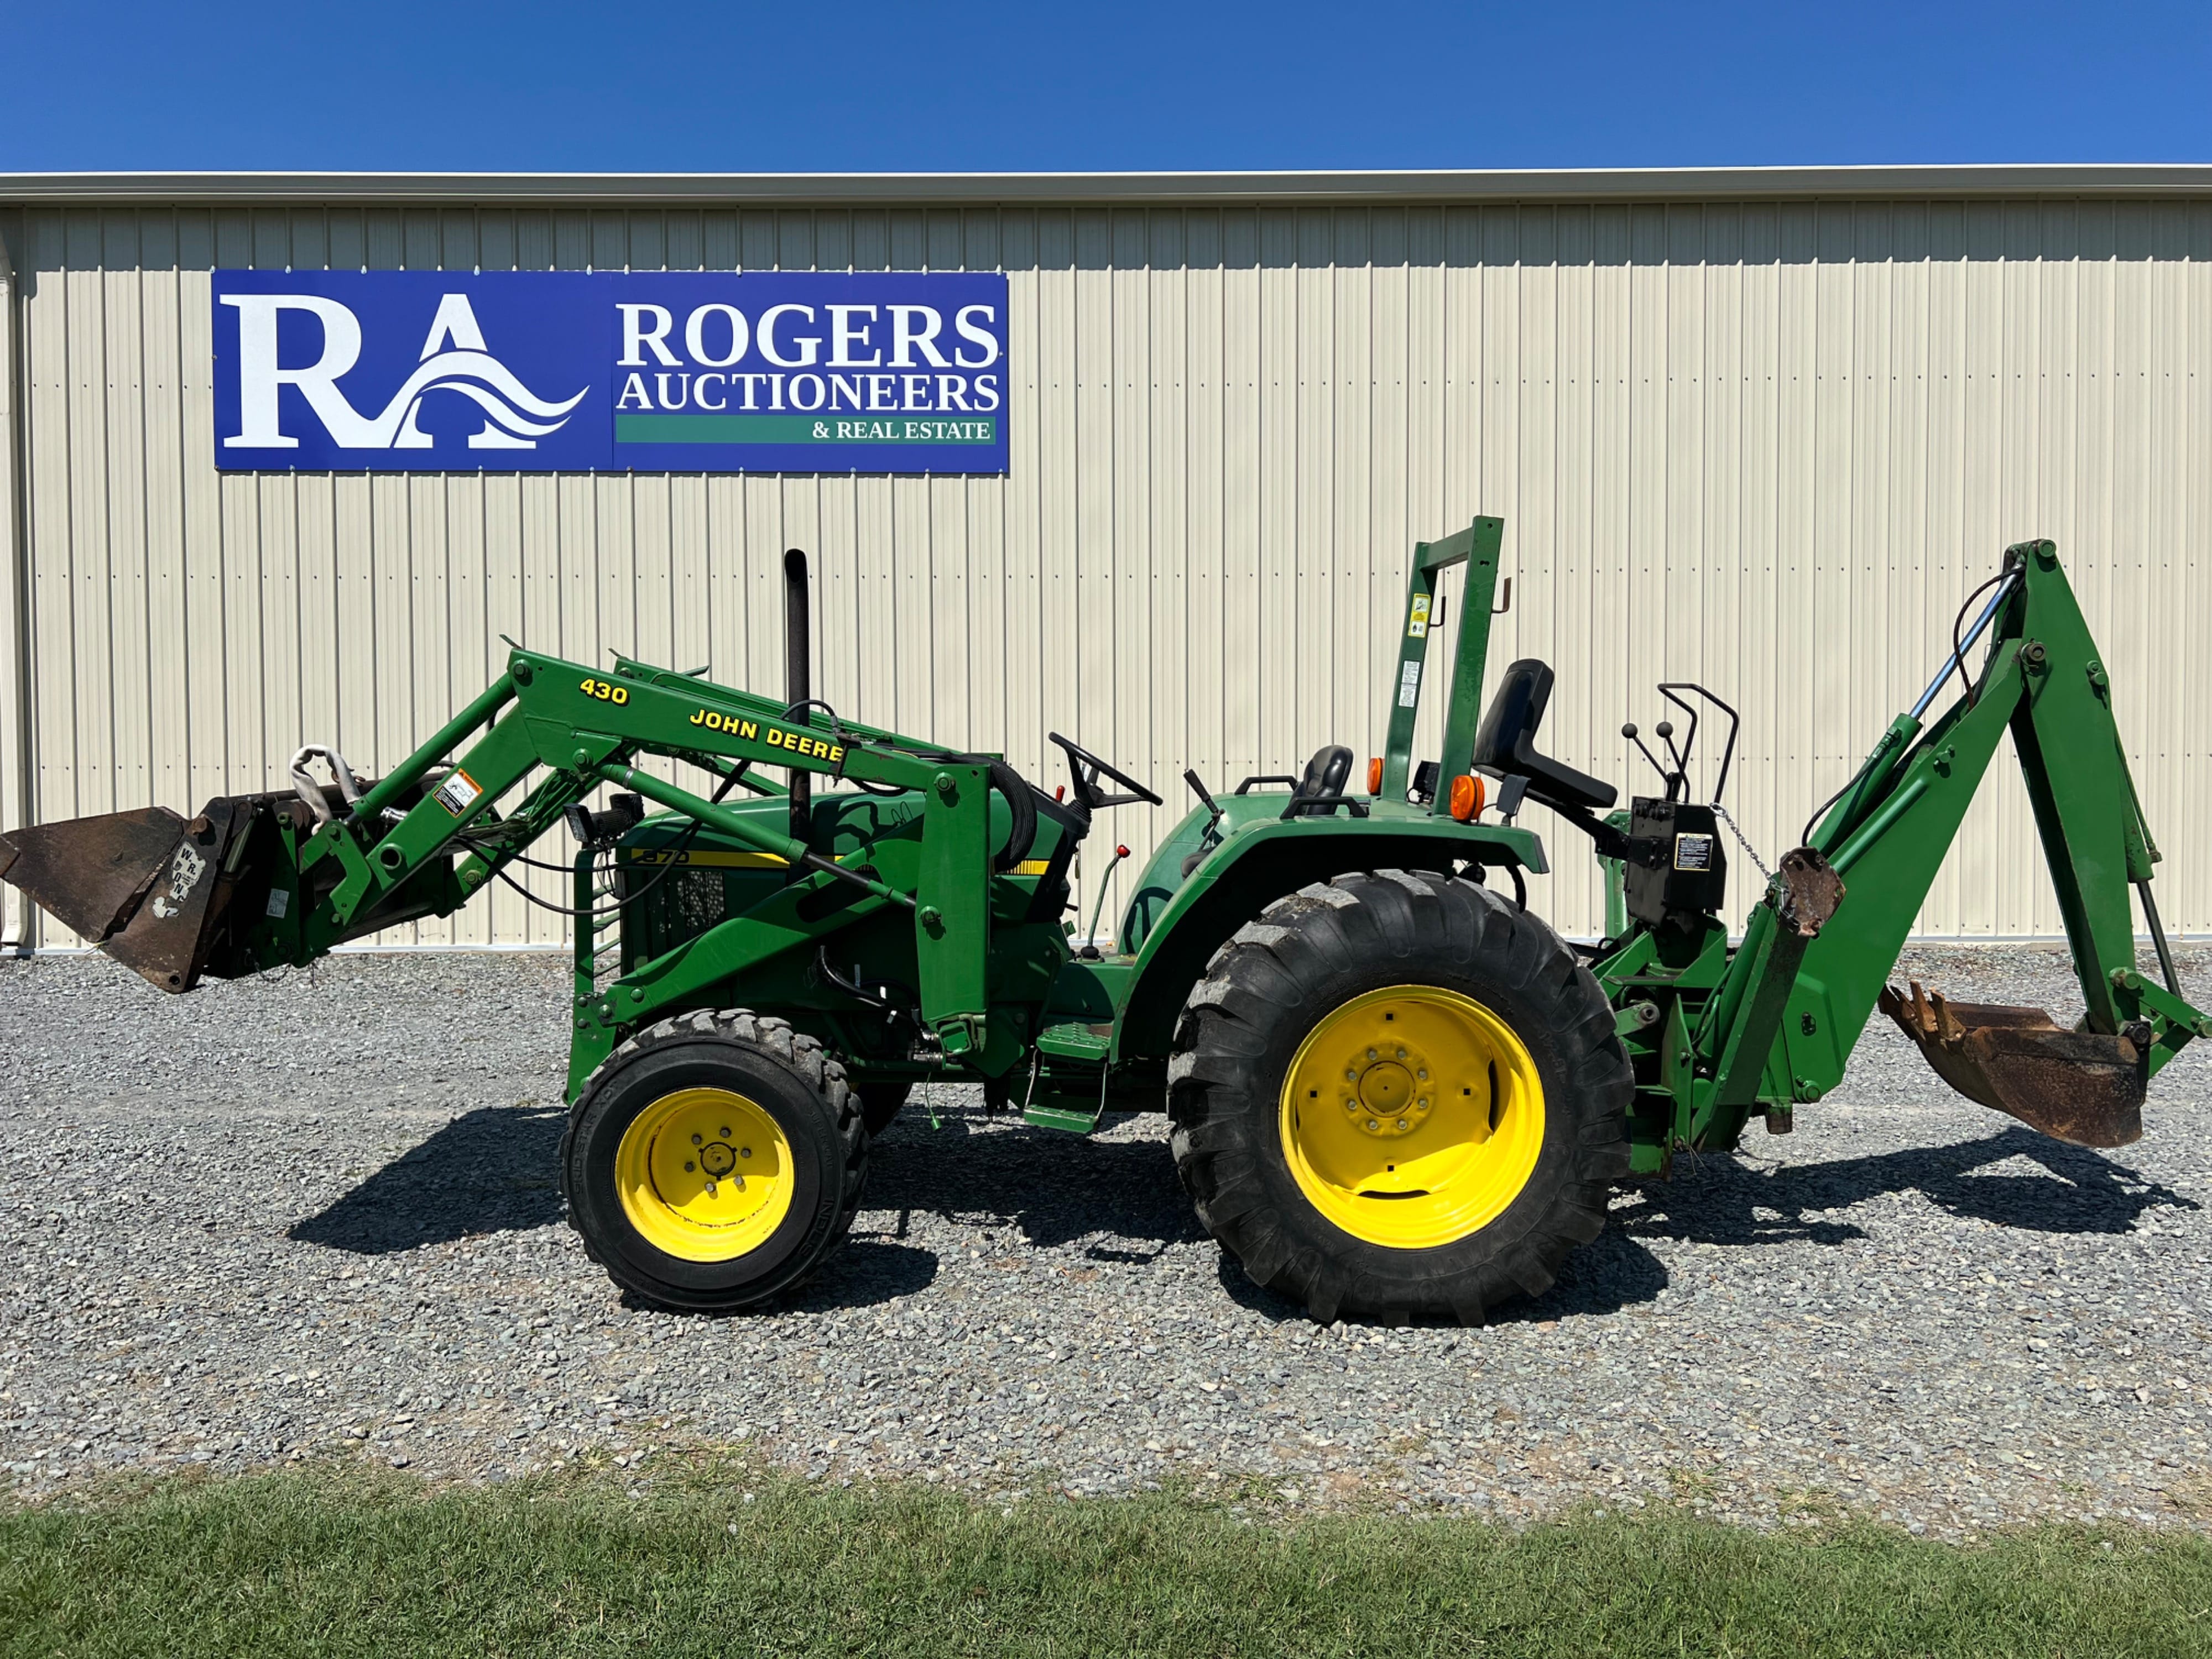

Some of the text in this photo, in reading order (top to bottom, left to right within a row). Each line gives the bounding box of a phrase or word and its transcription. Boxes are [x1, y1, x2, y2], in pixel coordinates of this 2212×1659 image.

[615, 304, 999, 368] ROGERS
[220, 294, 589, 448] RA
[615, 373, 1000, 411] AUCTIONEERS
[812, 422, 990, 439] & REAL ESTATE
[580, 679, 628, 705] 430
[690, 709, 843, 761] JOHN DEERE
